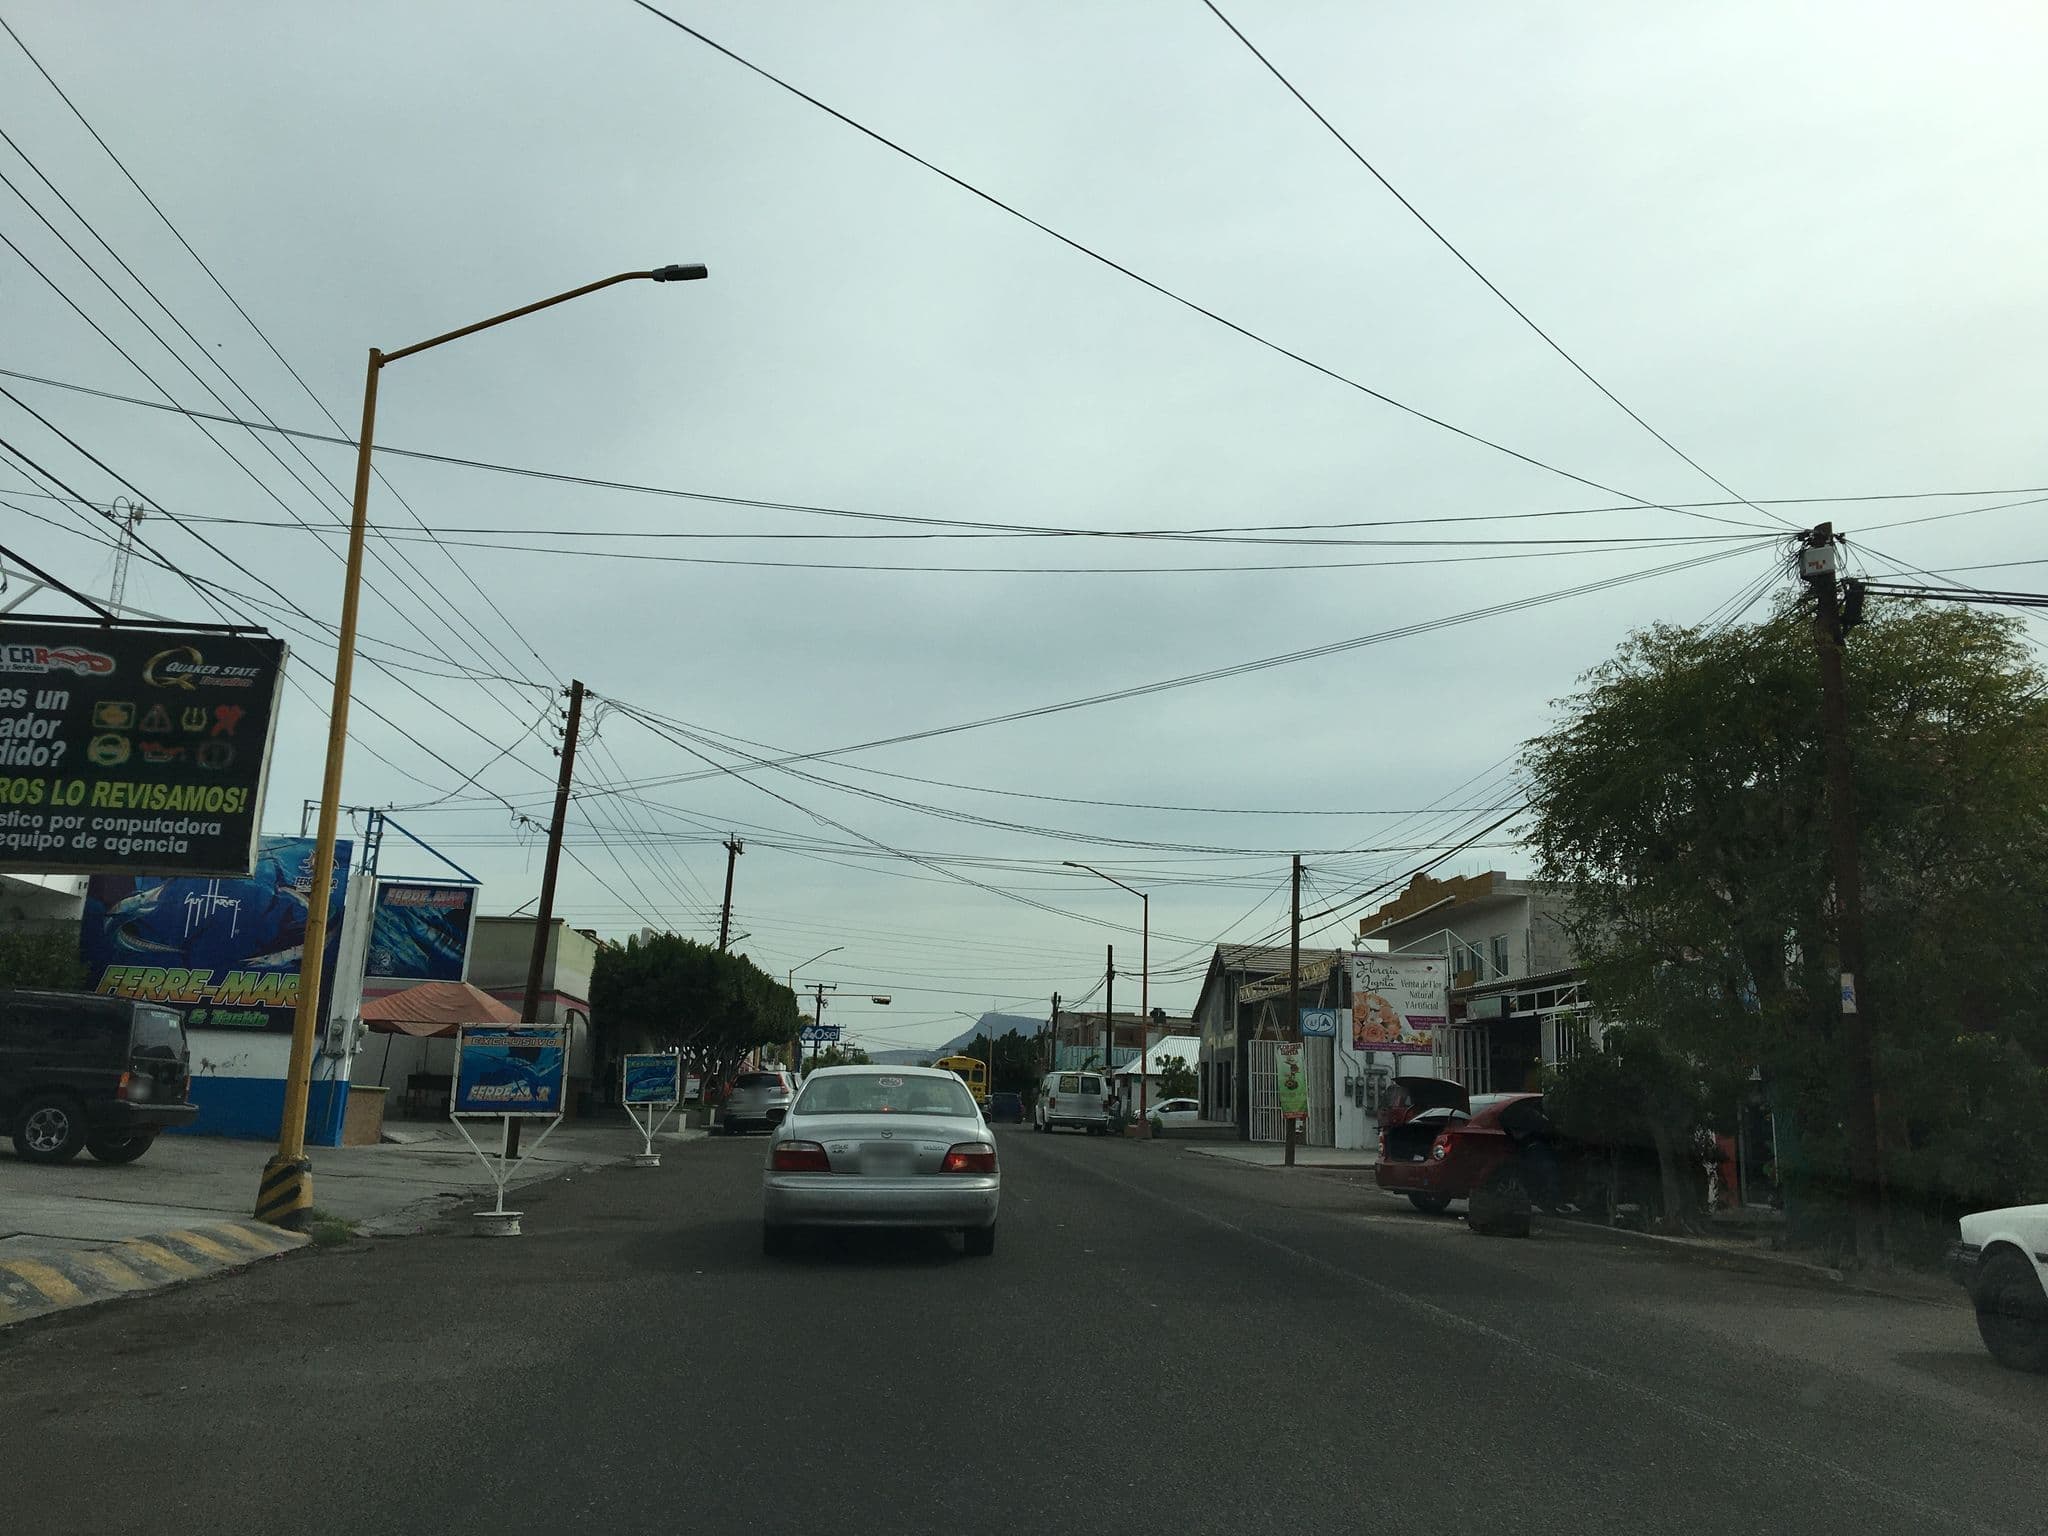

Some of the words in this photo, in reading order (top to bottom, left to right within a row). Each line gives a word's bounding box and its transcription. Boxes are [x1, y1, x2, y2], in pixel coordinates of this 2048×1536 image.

[165, 662, 220, 675] QUAKER
[220, 666, 262, 677] STATE
[34, 689, 70, 711] un
[50, 779, 86, 806] LO
[90, 781, 249, 814] REVISAMOS!
[49, 814, 85, 832] por
[91, 817, 222, 836] conputadora
[71, 832, 97, 849] de
[104, 836, 188, 855] agencia
[1410, 990, 1433, 999] Natural
[815, 1028, 839, 1039] Osel
